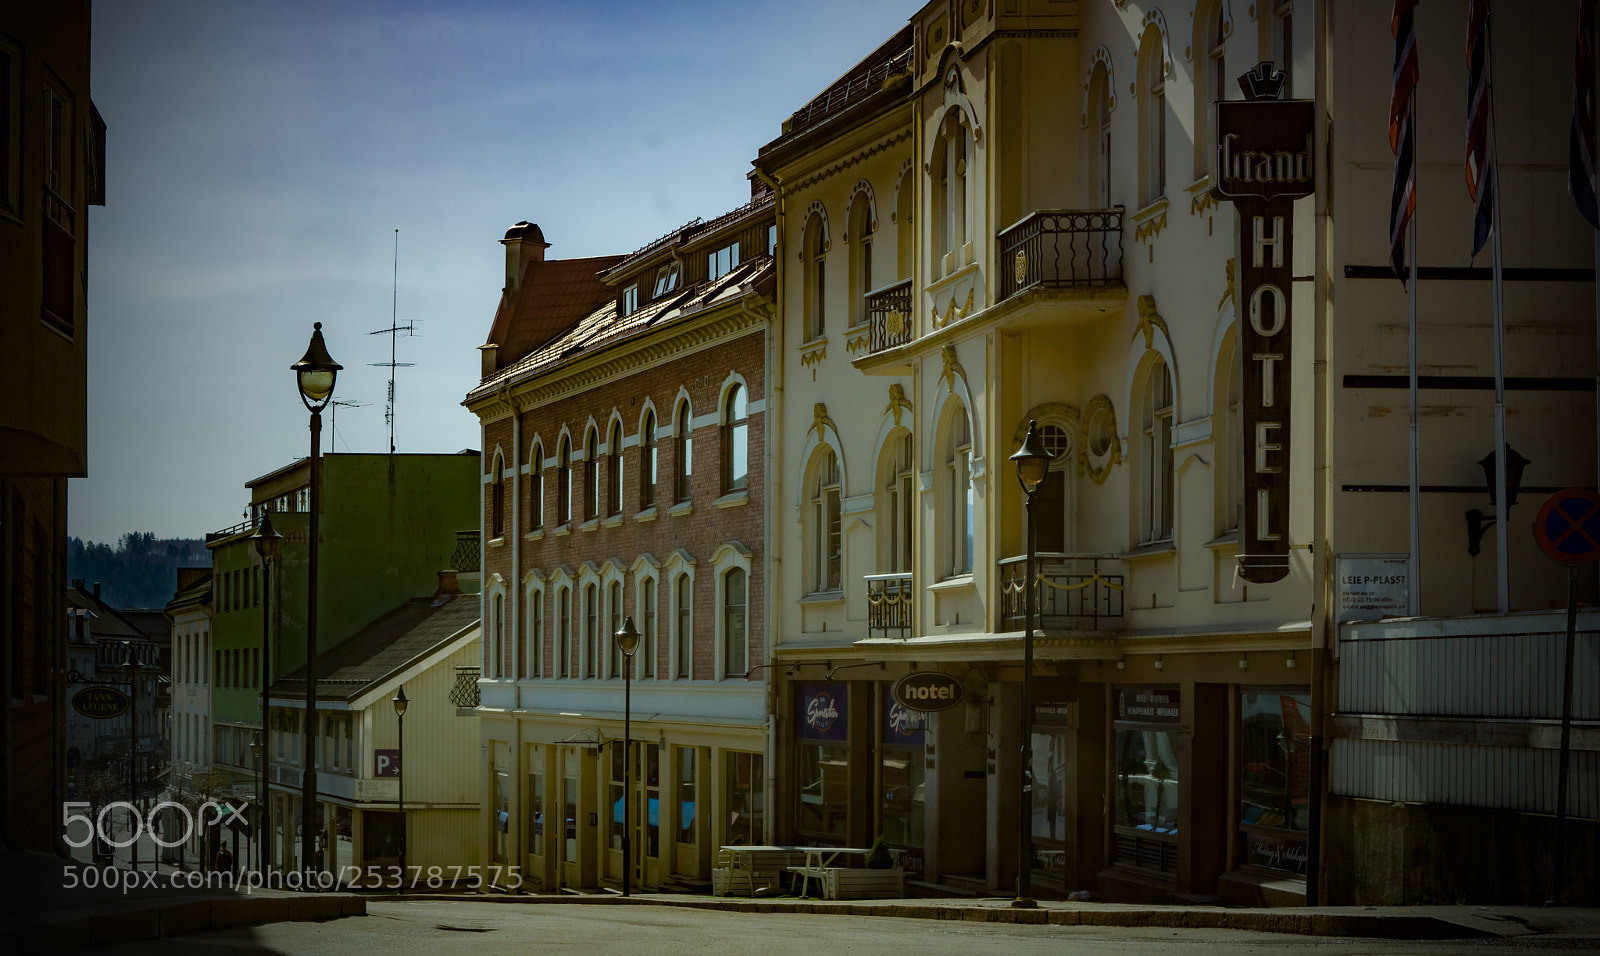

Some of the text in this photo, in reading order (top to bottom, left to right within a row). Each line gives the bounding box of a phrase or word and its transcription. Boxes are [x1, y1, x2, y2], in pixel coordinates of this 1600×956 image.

[1223, 130, 1314, 184] Grand
[1249, 215, 1287, 542] HOTEL
[1342, 575, 1406, 585] LEIE P-PLASS?
[905, 683, 955, 700] hotel
[377, 755, 391, 775] P
